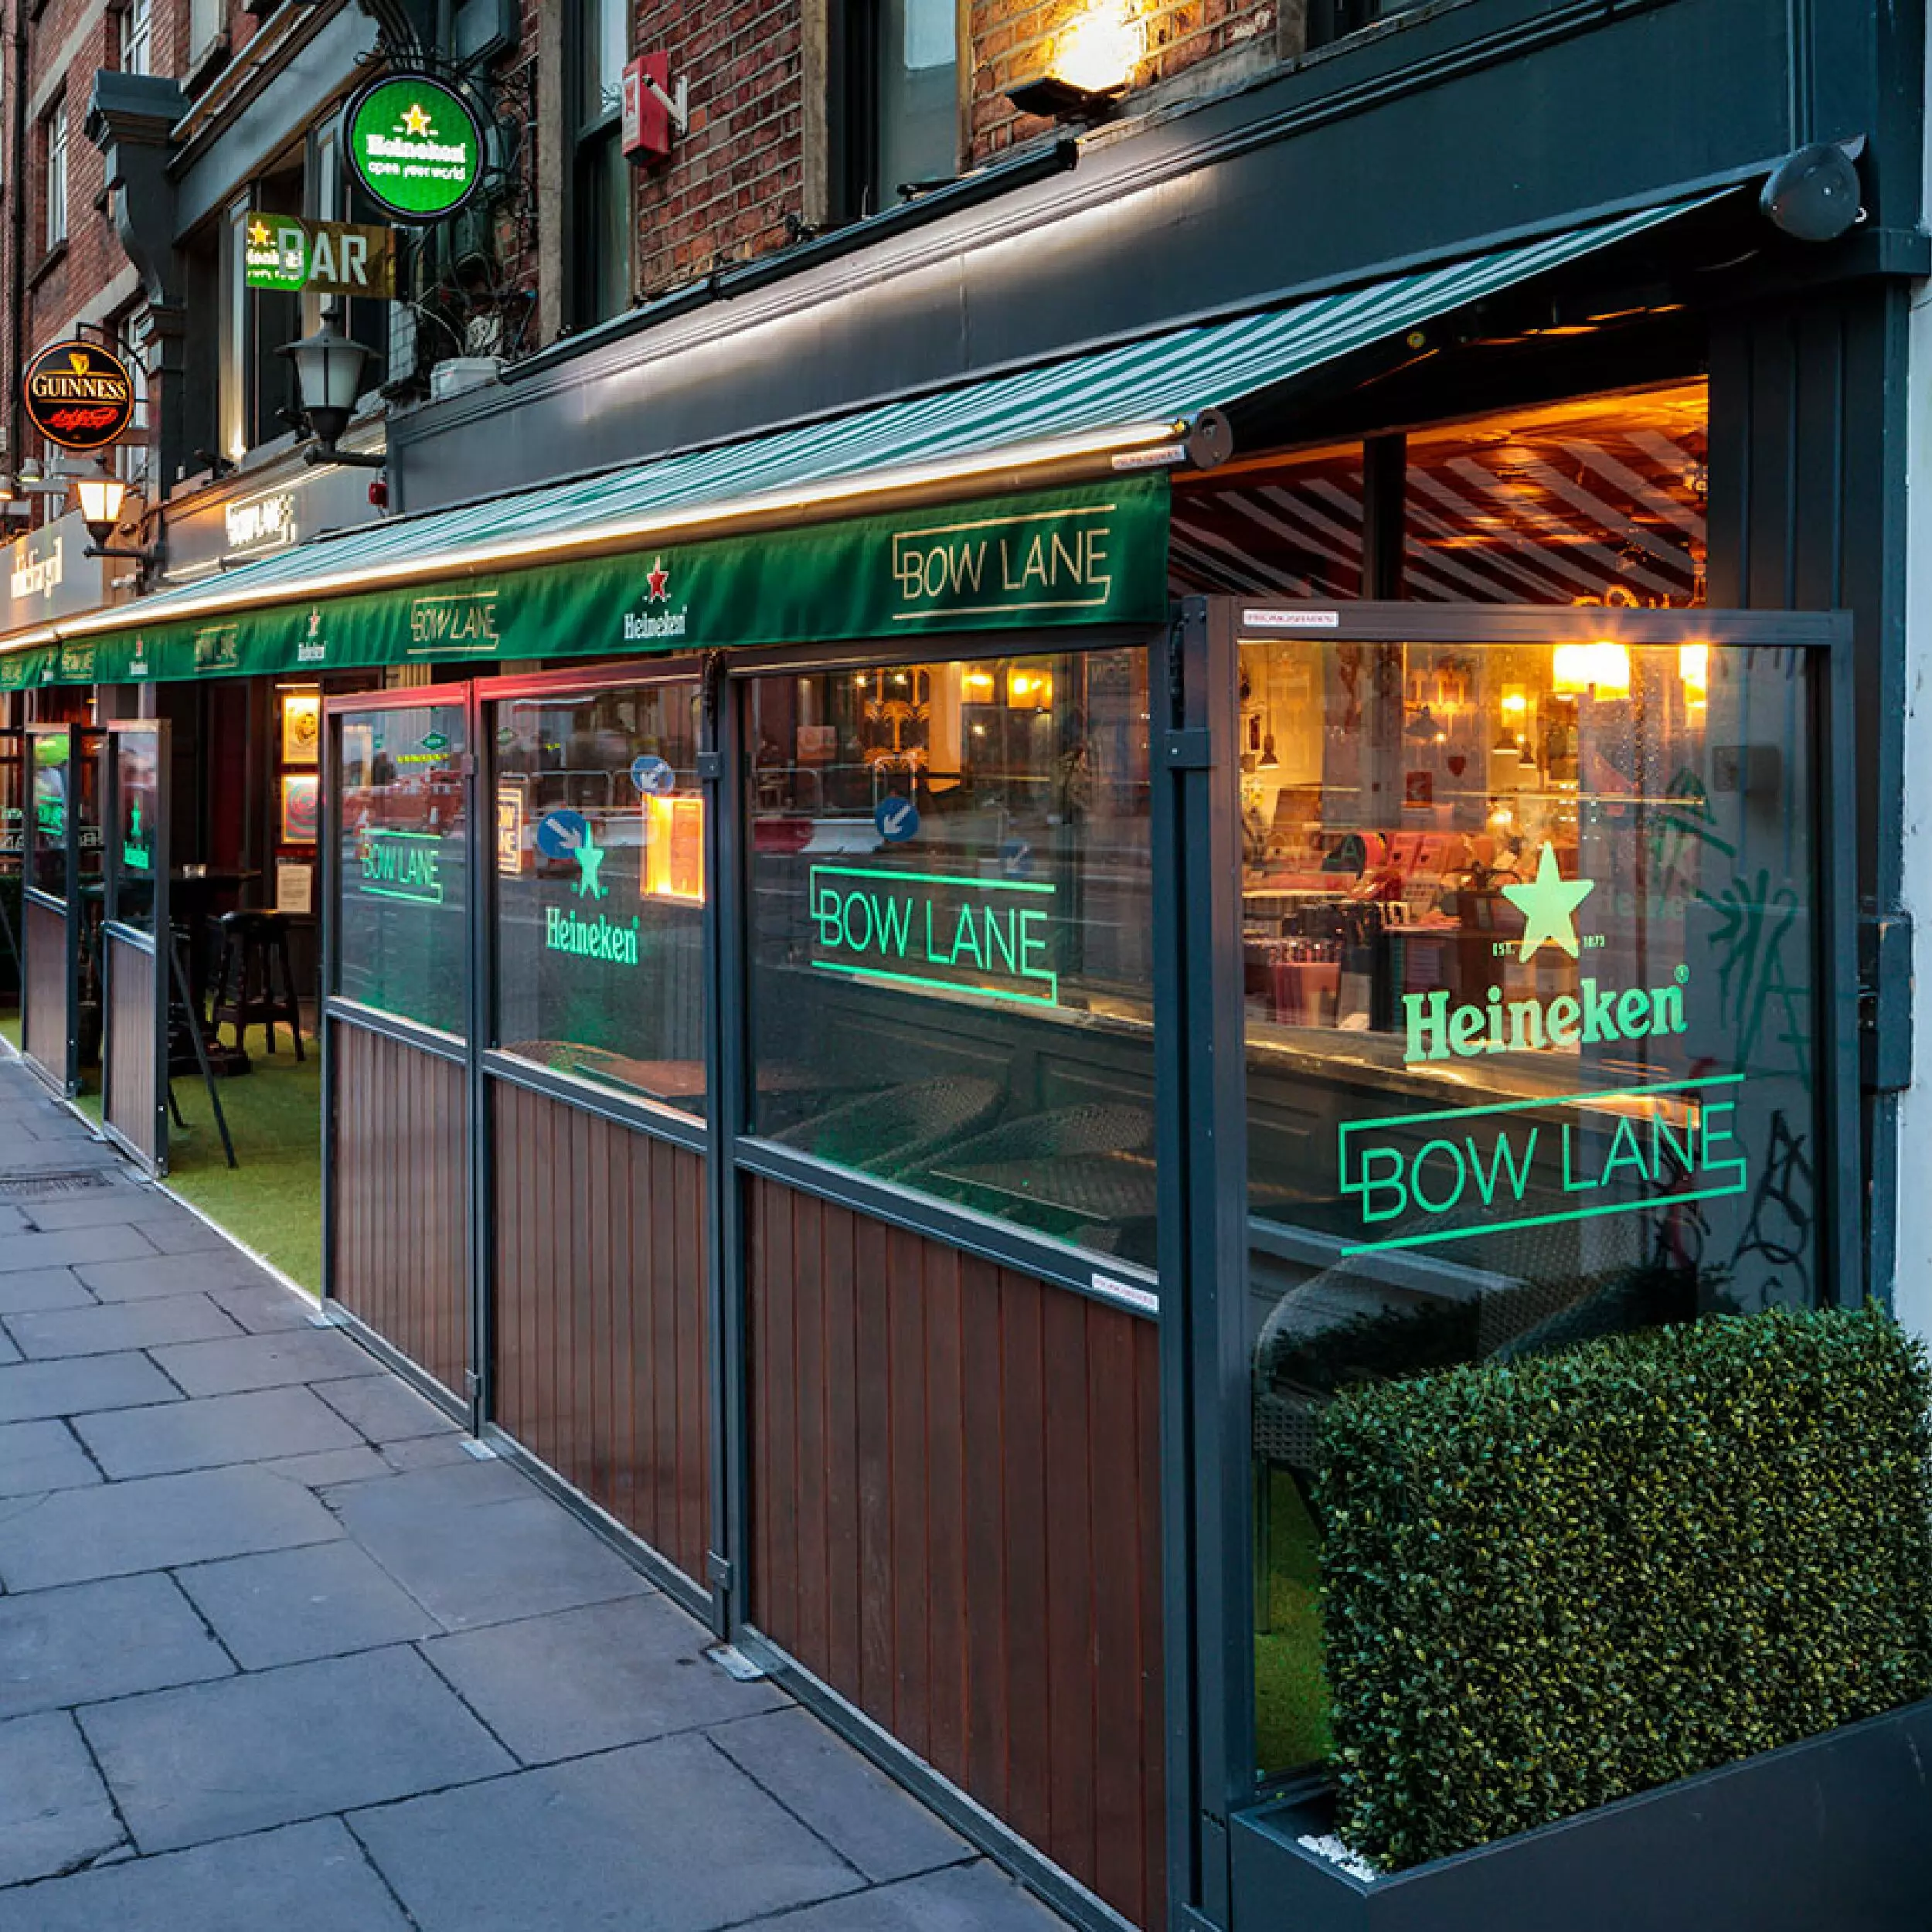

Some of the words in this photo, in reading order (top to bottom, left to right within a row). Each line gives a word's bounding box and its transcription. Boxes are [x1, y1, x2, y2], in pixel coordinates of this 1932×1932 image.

[278, 227, 368, 286] BAR
[32, 374, 128, 401] GUINNESS
[903, 540, 988, 600] BOW
[999, 528, 1111, 590] LANE
[413, 608, 451, 641] BOW
[450, 604, 497, 639] LANE
[624, 609, 687, 640] Heineken
[362, 843, 396, 879] BOW
[397, 847, 439, 886] LANE
[545, 906, 638, 965] Heineken
[820, 888, 913, 958] BOW
[926, 898, 1049, 978] LANE
[1401, 977, 1689, 1063] Heineken
[1362, 1127, 1539, 1223] BOW
[1561, 1100, 1736, 1192] LANE
